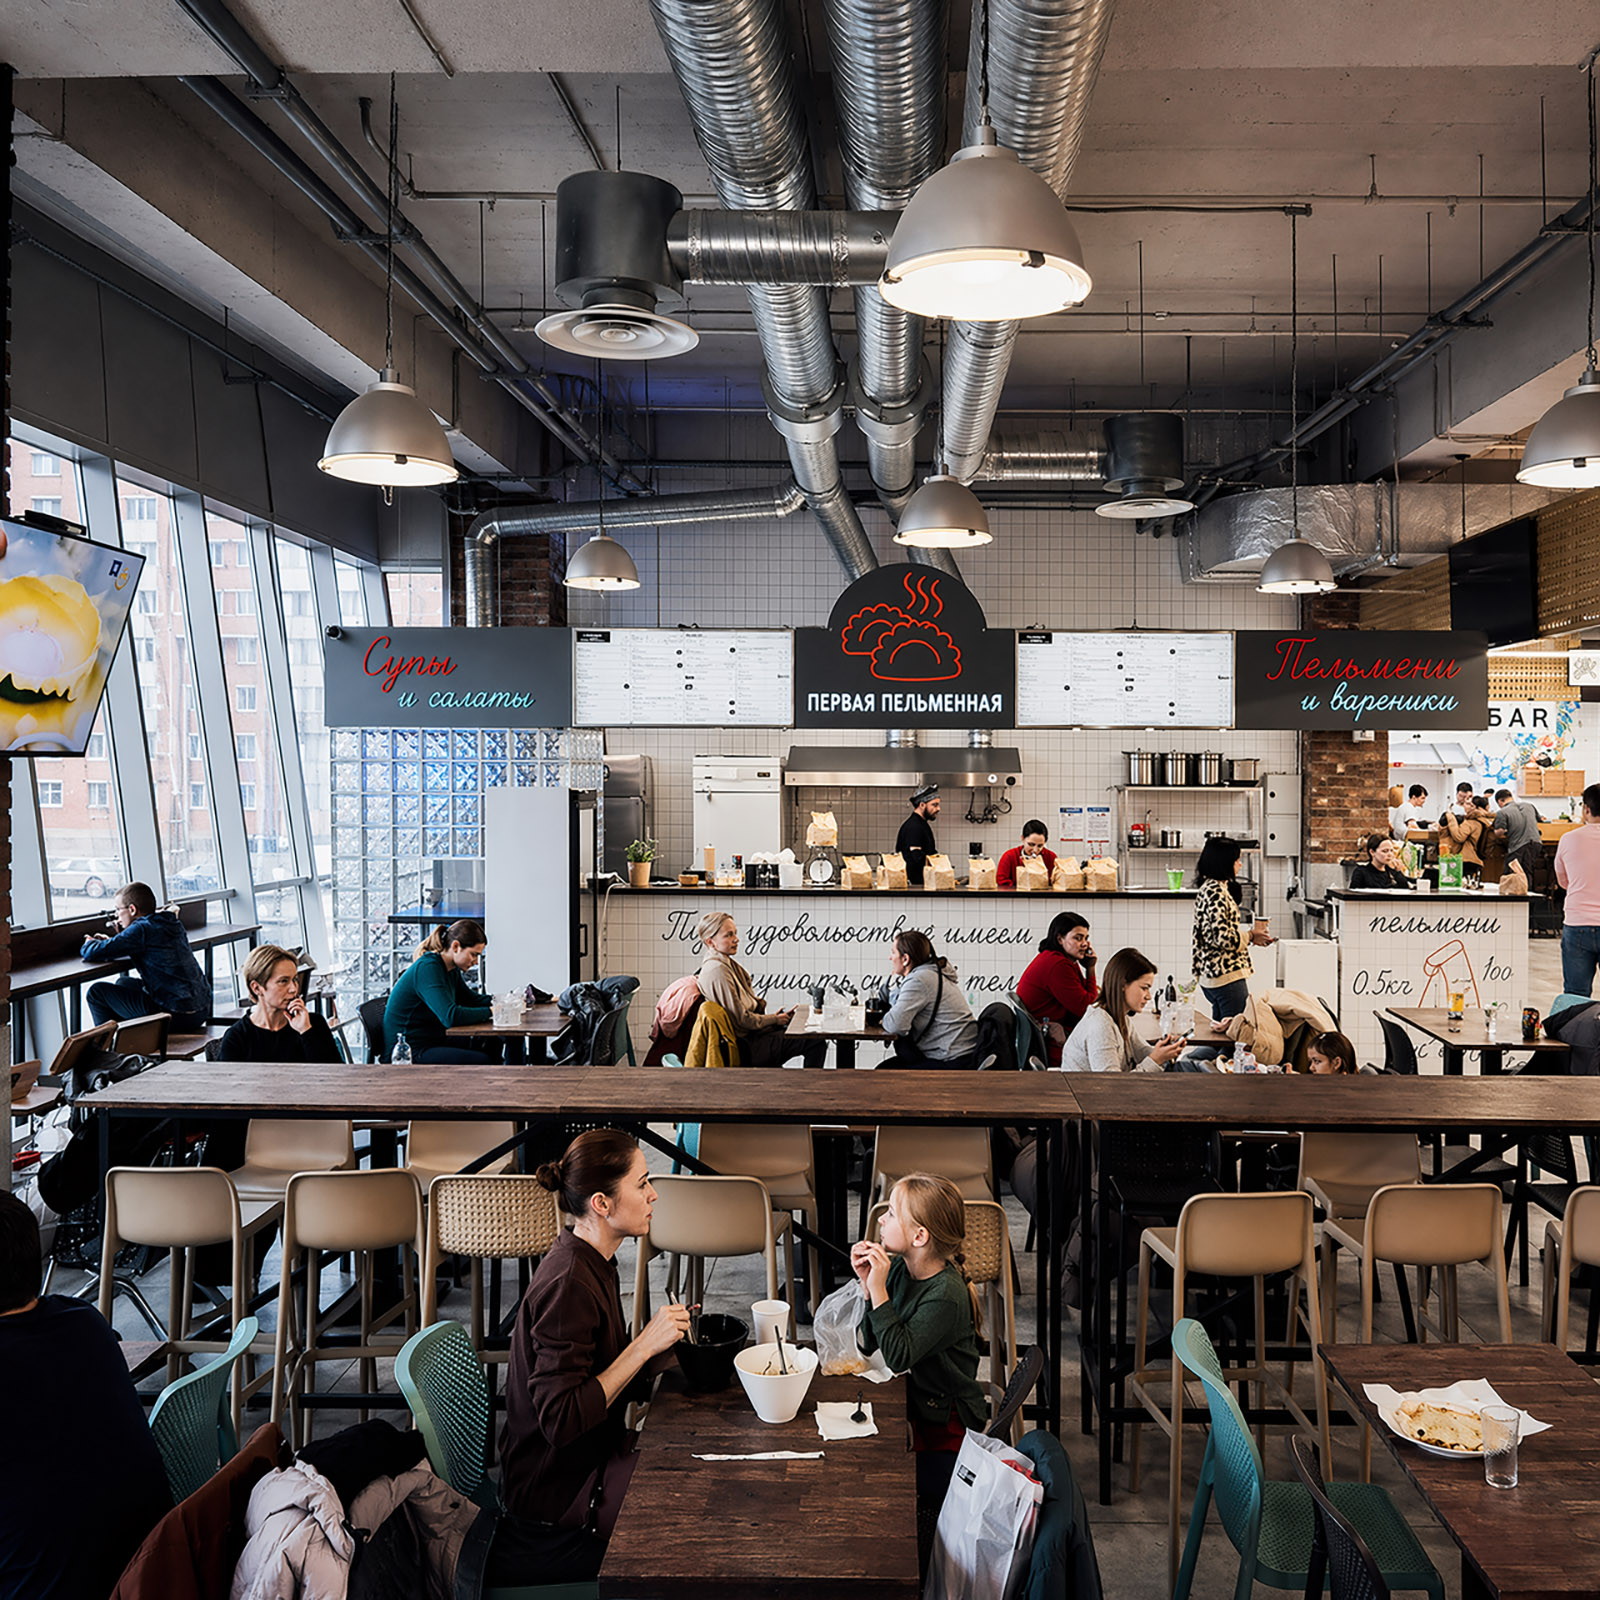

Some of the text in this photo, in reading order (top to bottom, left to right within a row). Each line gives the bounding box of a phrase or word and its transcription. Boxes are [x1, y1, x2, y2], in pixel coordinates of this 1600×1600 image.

[363, 635, 457, 692] Супы
[1266, 637, 1461, 681] Пельмени
[397, 690, 535, 708] и салаты
[807, 693, 1003, 713] ПЕРВАЯ ПЕЛЬМЕННАЯ
[1300, 681, 1459, 722] и вареники
[1369, 916, 1501, 934] пельмени
[943, 927, 1033, 945] имеем
